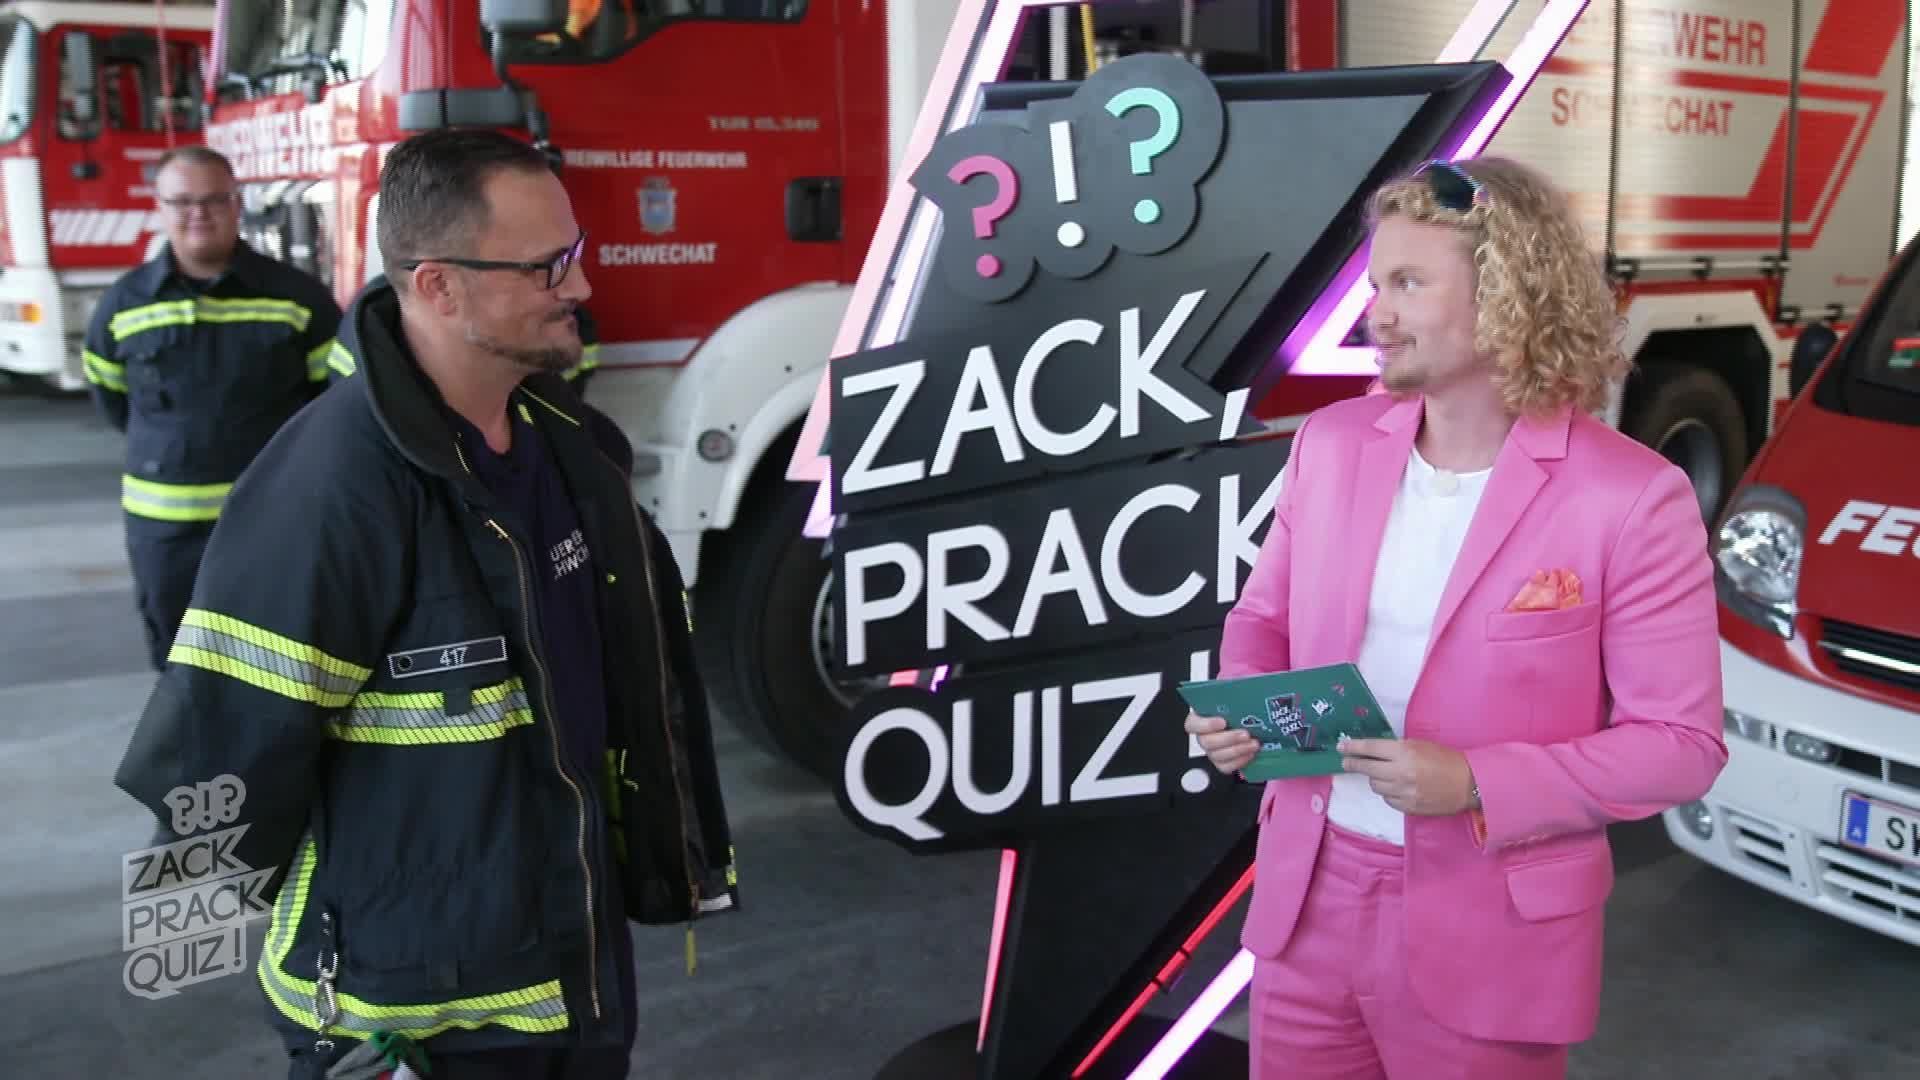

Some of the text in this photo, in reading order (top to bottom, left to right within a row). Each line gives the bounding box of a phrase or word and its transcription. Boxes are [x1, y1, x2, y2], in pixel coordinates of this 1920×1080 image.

[657, 151, 748, 168] FEUERWEHR
[599, 243, 717, 266] SCHWECHAT
[842, 289, 1251, 496] ZACK,
[1818, 499, 1920, 560] FE
[844, 463, 1288, 667] PRACK
[439, 647, 468, 667] 417
